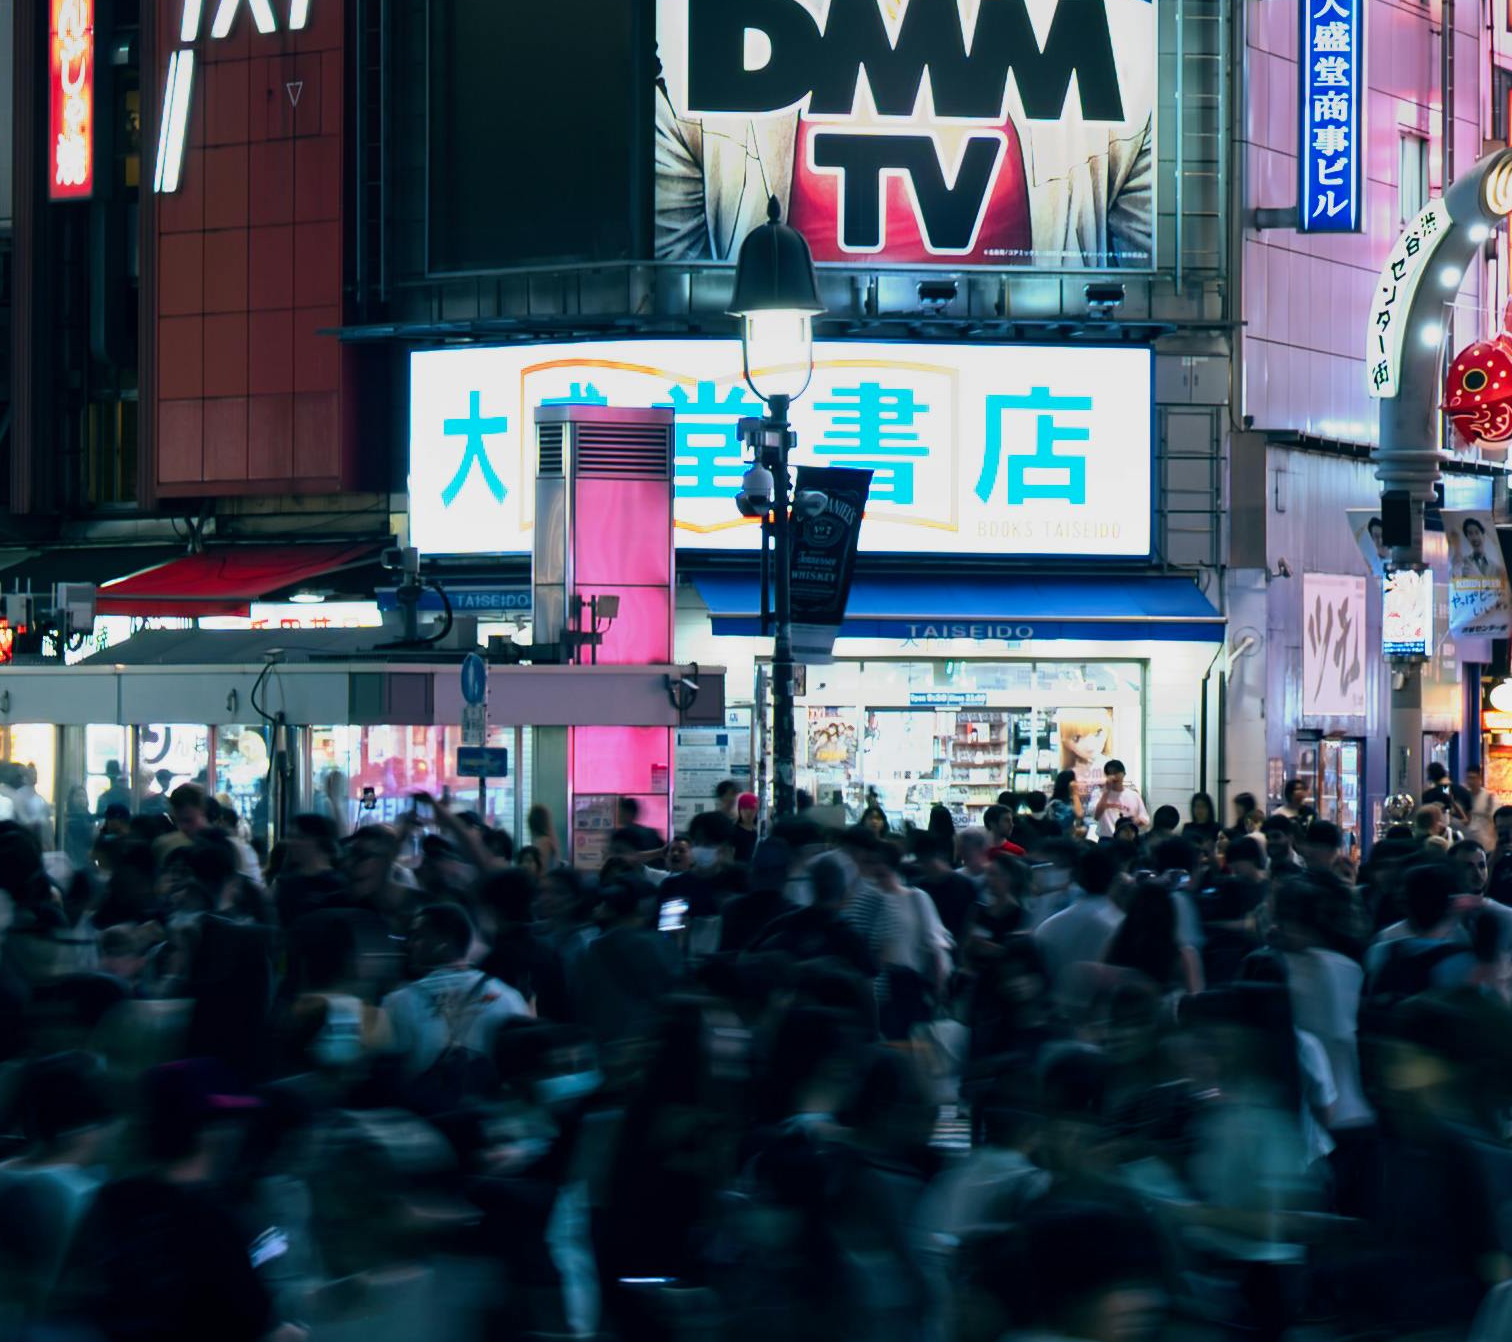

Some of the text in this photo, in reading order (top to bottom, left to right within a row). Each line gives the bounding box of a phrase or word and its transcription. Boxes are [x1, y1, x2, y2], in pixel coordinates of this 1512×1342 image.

[813, 132, 1004, 253] TV
[1372, 210, 1438, 391] 渋谷センター街
[440, 381, 1092, 507] 大堂書店
[825, 497, 857, 526] ANIEL'S
[976, 520, 1123, 540] BOOKS TAISEIDO
[455, 594, 529, 608] TAISEIDO
[905, 624, 1035, 639] TAISEIDO
